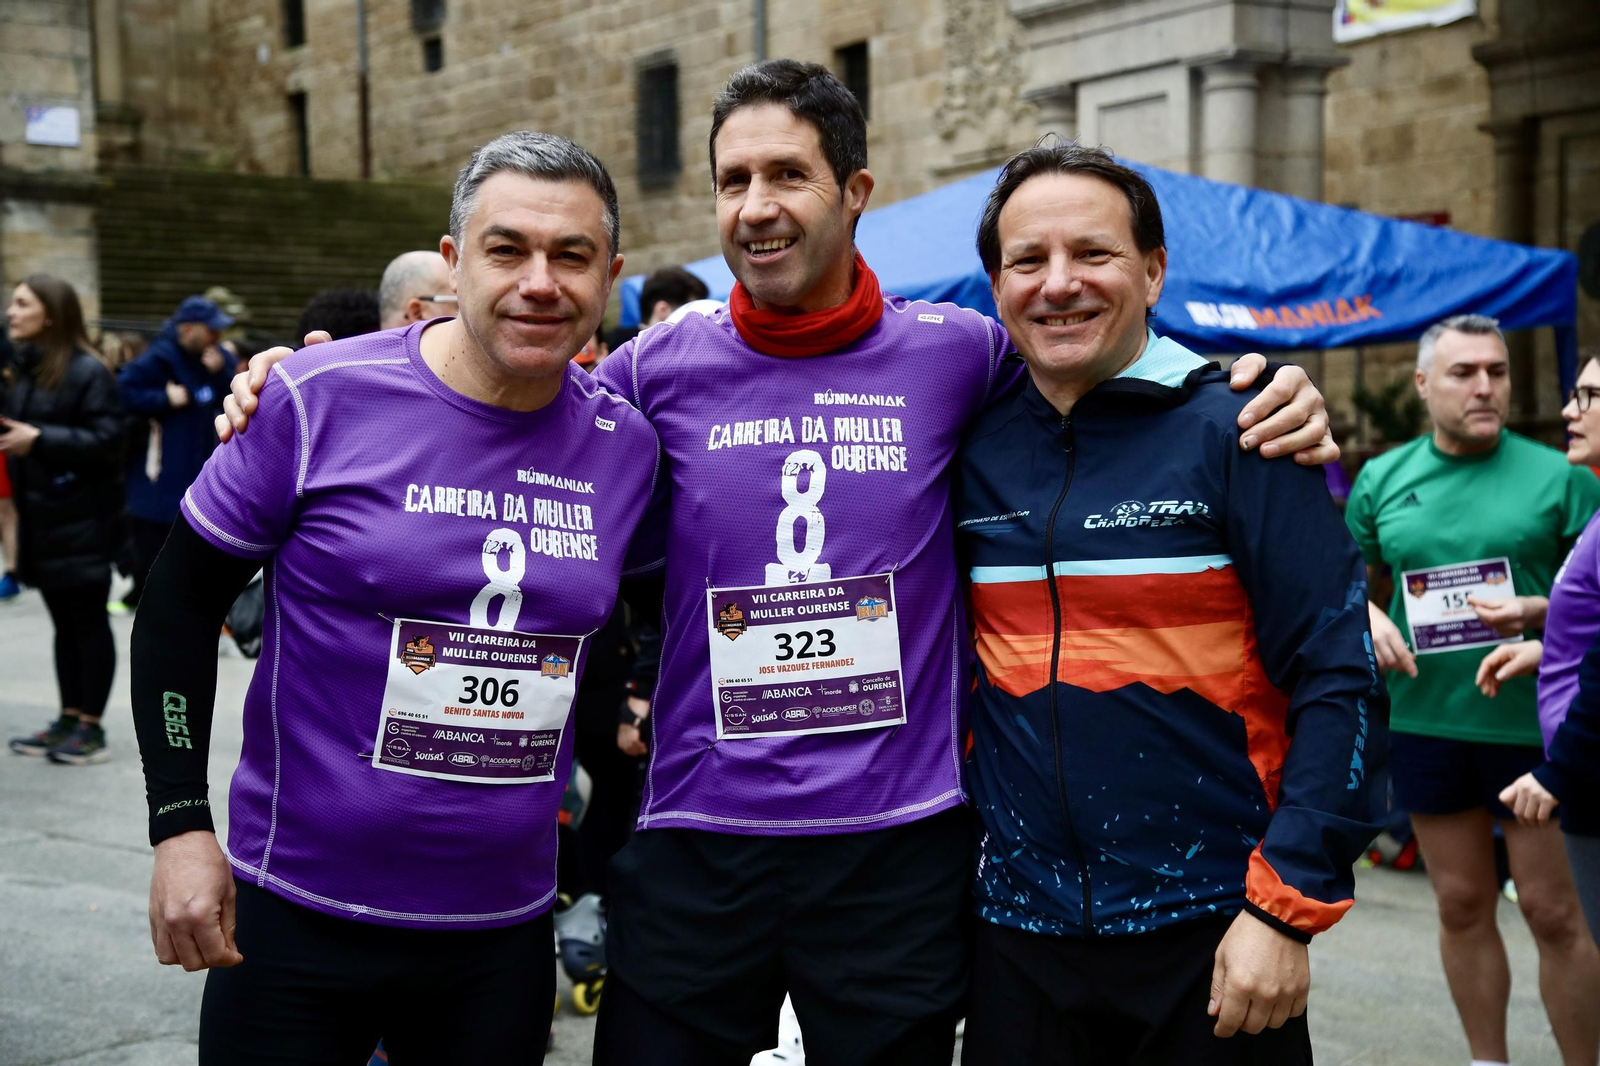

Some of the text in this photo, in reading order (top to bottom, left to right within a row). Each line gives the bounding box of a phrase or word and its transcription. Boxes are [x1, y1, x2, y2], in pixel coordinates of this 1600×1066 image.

[814, 388, 906, 407] RUNMANIAK
[706, 416, 903, 451] CARREIRA DA MULLER
[831, 444, 909, 473] OURENSE
[516, 466, 595, 494] RUNMANIAK
[403, 483, 594, 531] CARREIRA DA MULLER
[530, 527, 600, 561] OURENSE
[751, 586, 845, 604] VII CARREIRA DA
[750, 601, 850, 620] MULLER OURENSE
[448, 631, 537, 649] VII CARREIRA DA
[773, 628, 837, 662] 323
[442, 647, 538, 664] MULLER OURENSE
[758, 657, 855, 675] JOSE VAZQUEZ FERNANDEZ
[861, 676, 884, 684] Concello
[862, 680, 897, 692] OURENSE
[458, 675, 520, 708] 306
[824, 688, 842, 696] inorde
[444, 706, 525, 720] BENITO SANTAS NOVOA
[785, 709, 808, 719] ABRIL
[386, 743, 411, 752] NISSAN
[530, 739, 556, 747] OURENSE
[451, 754, 475, 764] ABRIL
